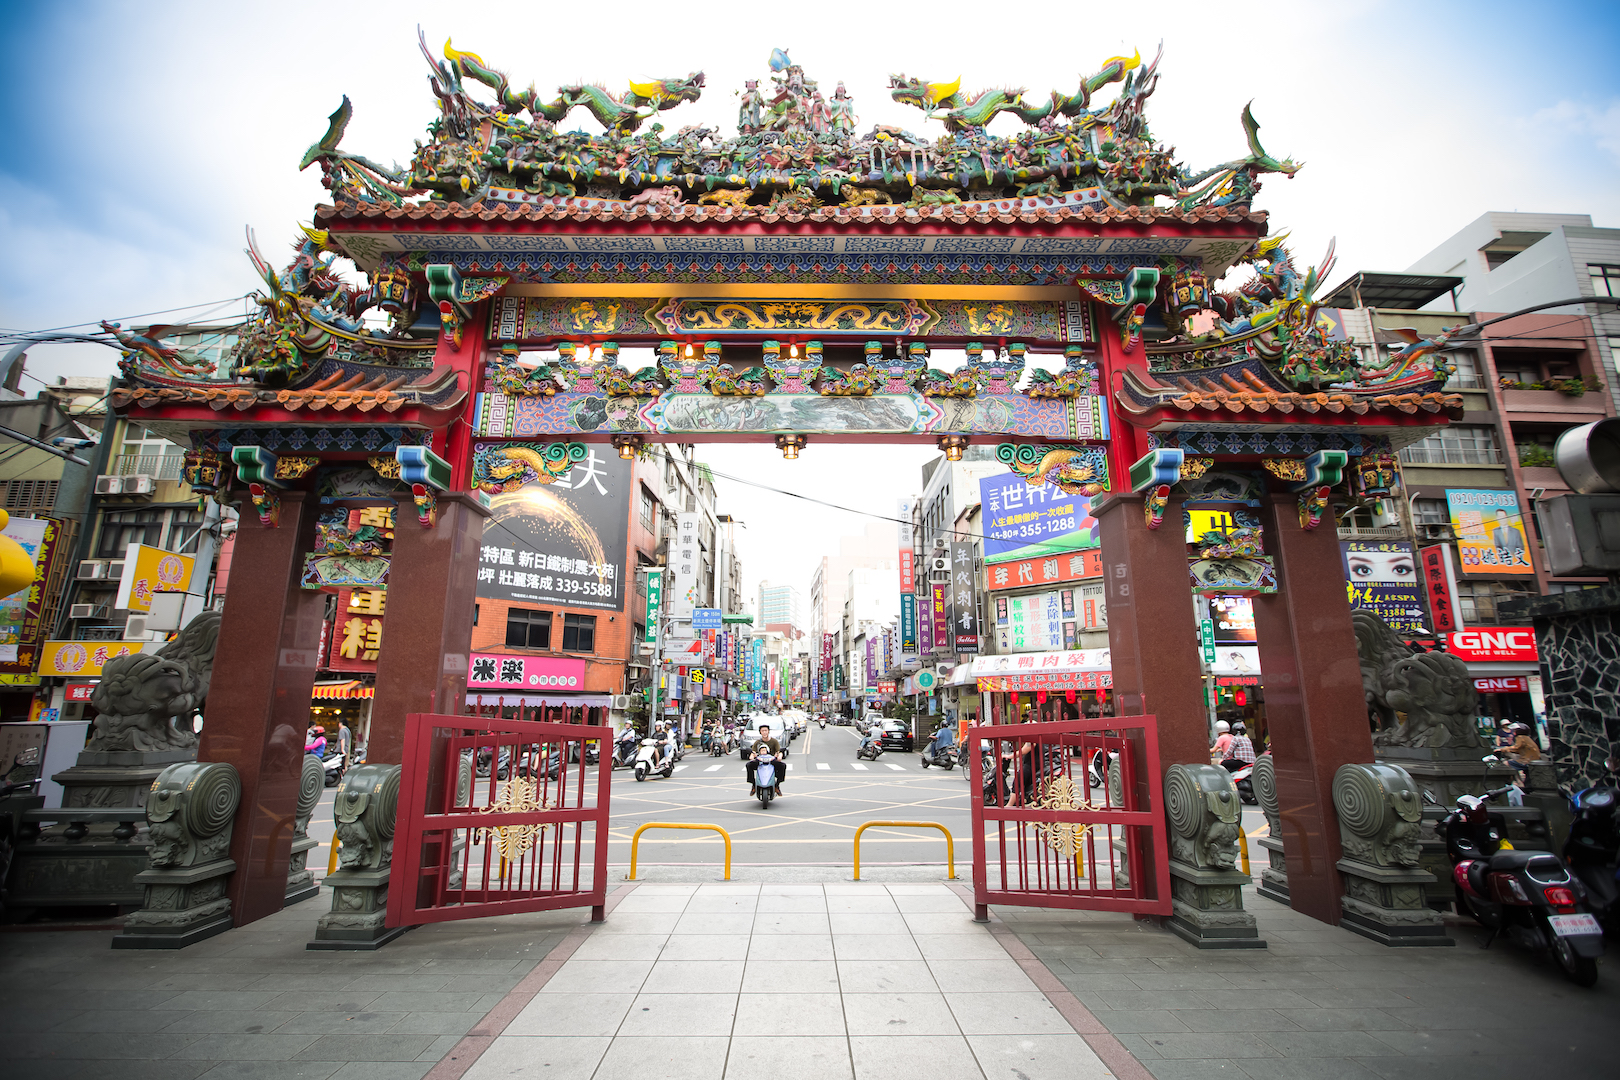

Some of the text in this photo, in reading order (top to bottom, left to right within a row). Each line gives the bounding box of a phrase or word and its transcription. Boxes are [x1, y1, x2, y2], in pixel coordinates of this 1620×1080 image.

[1449, 492, 1516, 507] 0920-023-033
[990, 503, 1075, 528] 人生最驕傲的一次收藏
[1019, 516, 1076, 537] 355-1288
[681, 521, 692, 574] 中華電信
[498, 569, 553, 594] 壯麗落成
[555, 578, 612, 598] 339-5588
[994, 555, 1086, 586] 年代刺青
[955, 548, 974, 630] 年代刺青
[1083, 587, 1103, 596] TATTOO
[1428, 553, 1450, 627] 國際飲食店
[1013, 599, 1025, 648] 無痛紋身
[1028, 597, 1042, 647] 圖形修改
[1046, 595, 1060, 646] 去除刺青
[1203, 626, 1214, 656] 中正路
[1453, 632, 1532, 649] GNC
[1018, 653, 1086, 669] 鴨肉榮
[1474, 678, 1517, 689] GNC
